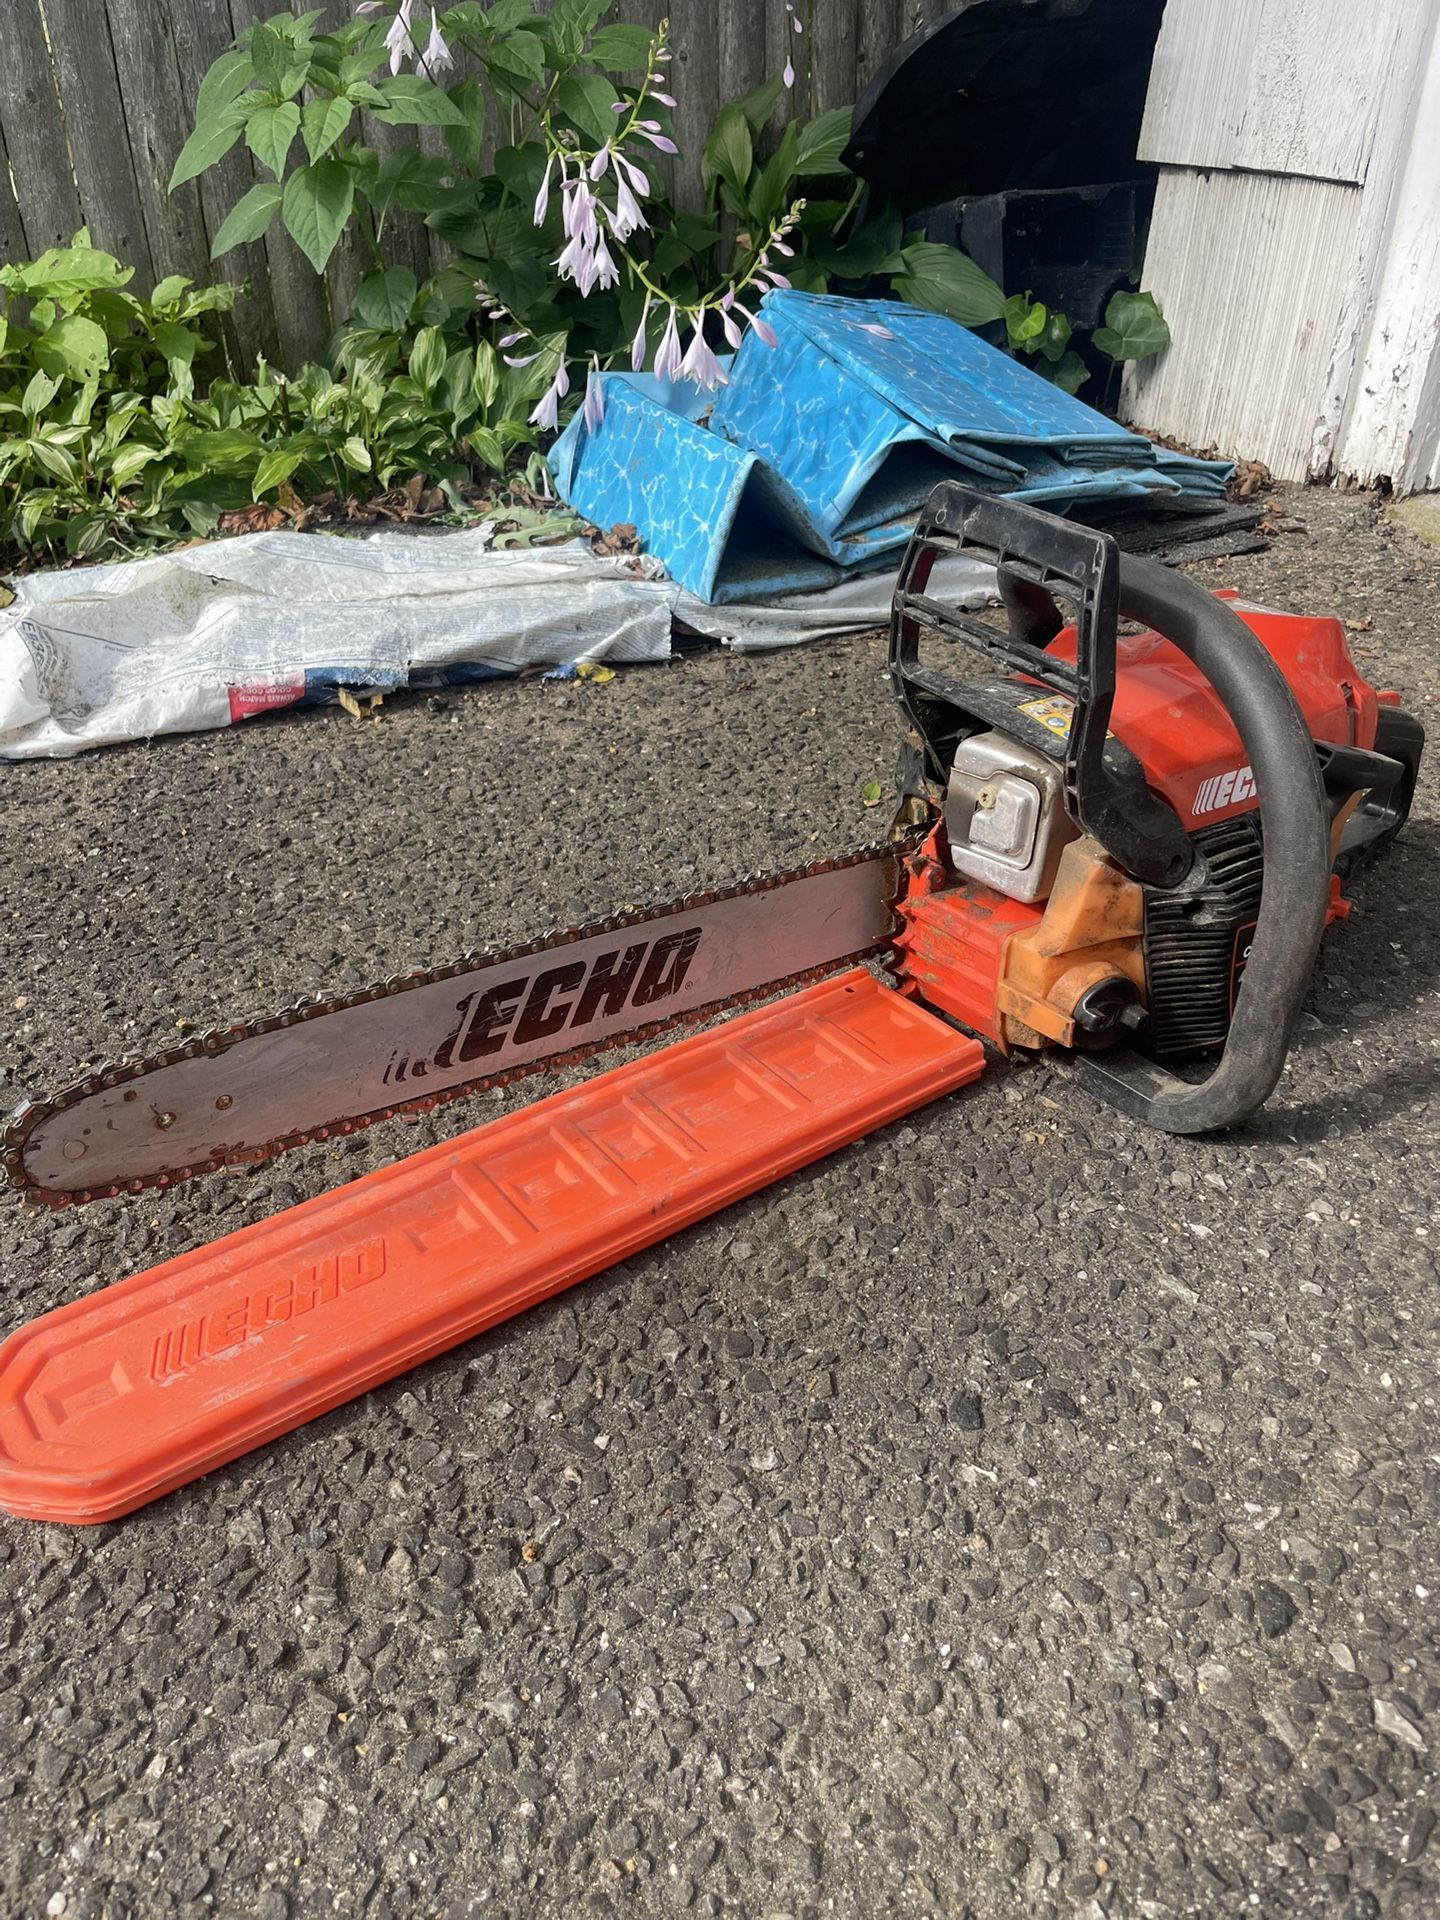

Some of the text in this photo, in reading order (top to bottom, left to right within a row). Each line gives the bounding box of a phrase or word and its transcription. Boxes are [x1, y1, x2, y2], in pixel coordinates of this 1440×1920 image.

[240, 694, 266, 704] MATCH
[1209, 766, 1257, 809] EC
[455, 926, 703, 1064] ECHO
[202, 1238, 386, 1358] ECHO
